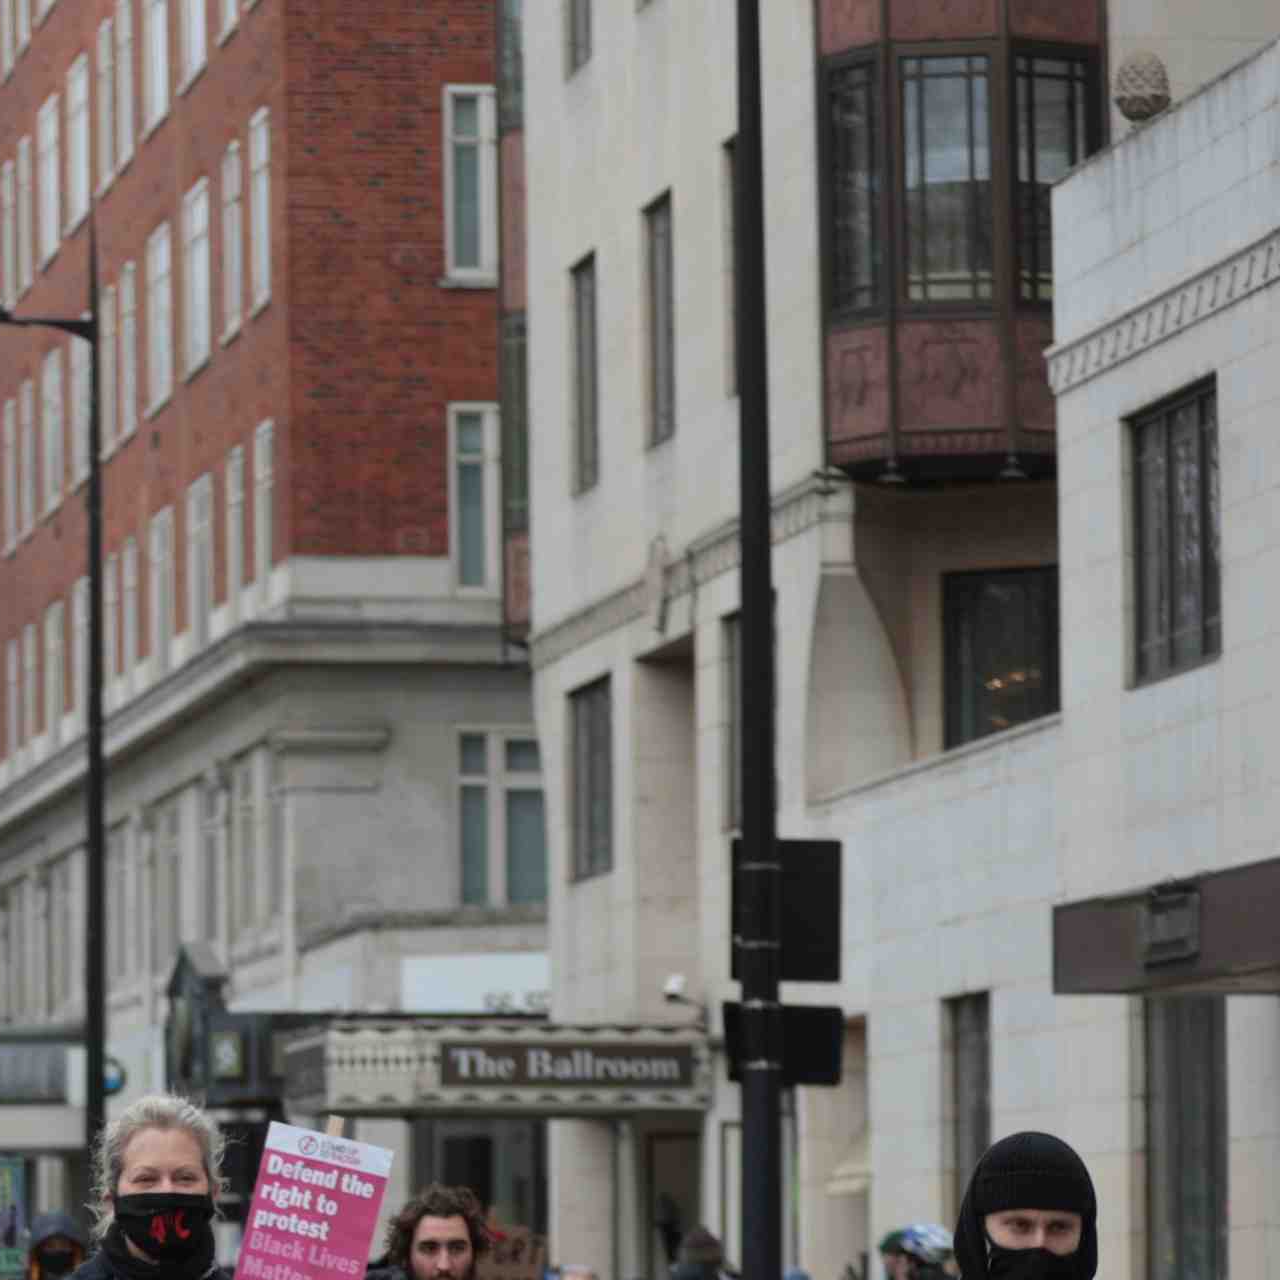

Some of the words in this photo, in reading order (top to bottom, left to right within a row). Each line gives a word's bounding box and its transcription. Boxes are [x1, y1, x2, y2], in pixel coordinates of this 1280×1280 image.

[448, 1048, 516, 1079] The
[526, 1048, 681, 1079] Ballroom
[267, 1154, 339, 1189] Defend
[342, 1172, 374, 1198] the
[260, 1182, 312, 1209] right
[317, 1194, 337, 1215] to
[254, 1209, 330, 1240] protest
[250, 1230, 304, 1260] Black
[308, 1244, 360, 1275] Lives
